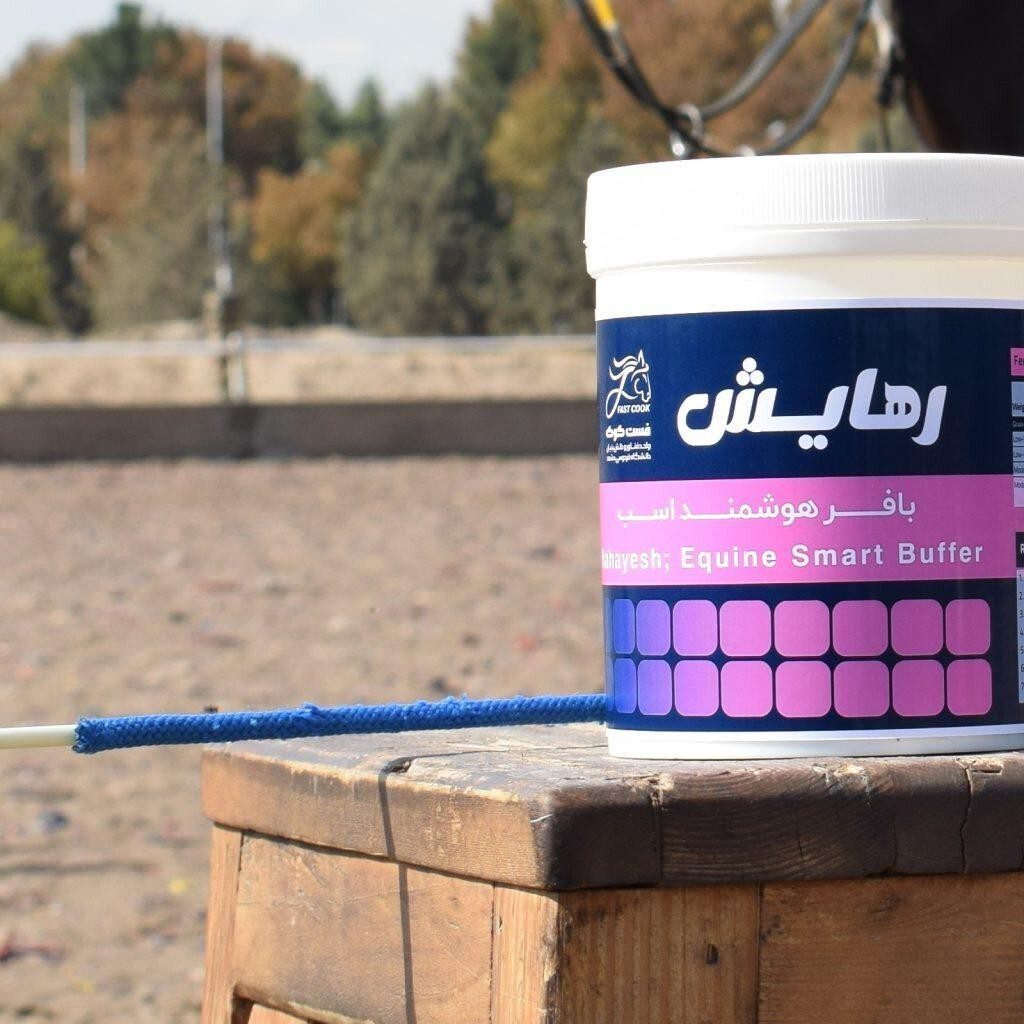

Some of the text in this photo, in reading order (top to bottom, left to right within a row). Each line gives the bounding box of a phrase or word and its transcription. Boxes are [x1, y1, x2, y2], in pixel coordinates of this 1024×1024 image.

[617, 404, 651, 414] FAST COOK
[677, 357, 947, 450] رهایش
[617, 489, 916, 528] بافر هوشمند اسب
[681, 545, 778, 574] Equine
[792, 544, 884, 567] Smart
[899, 541, 983, 564] Buffer
